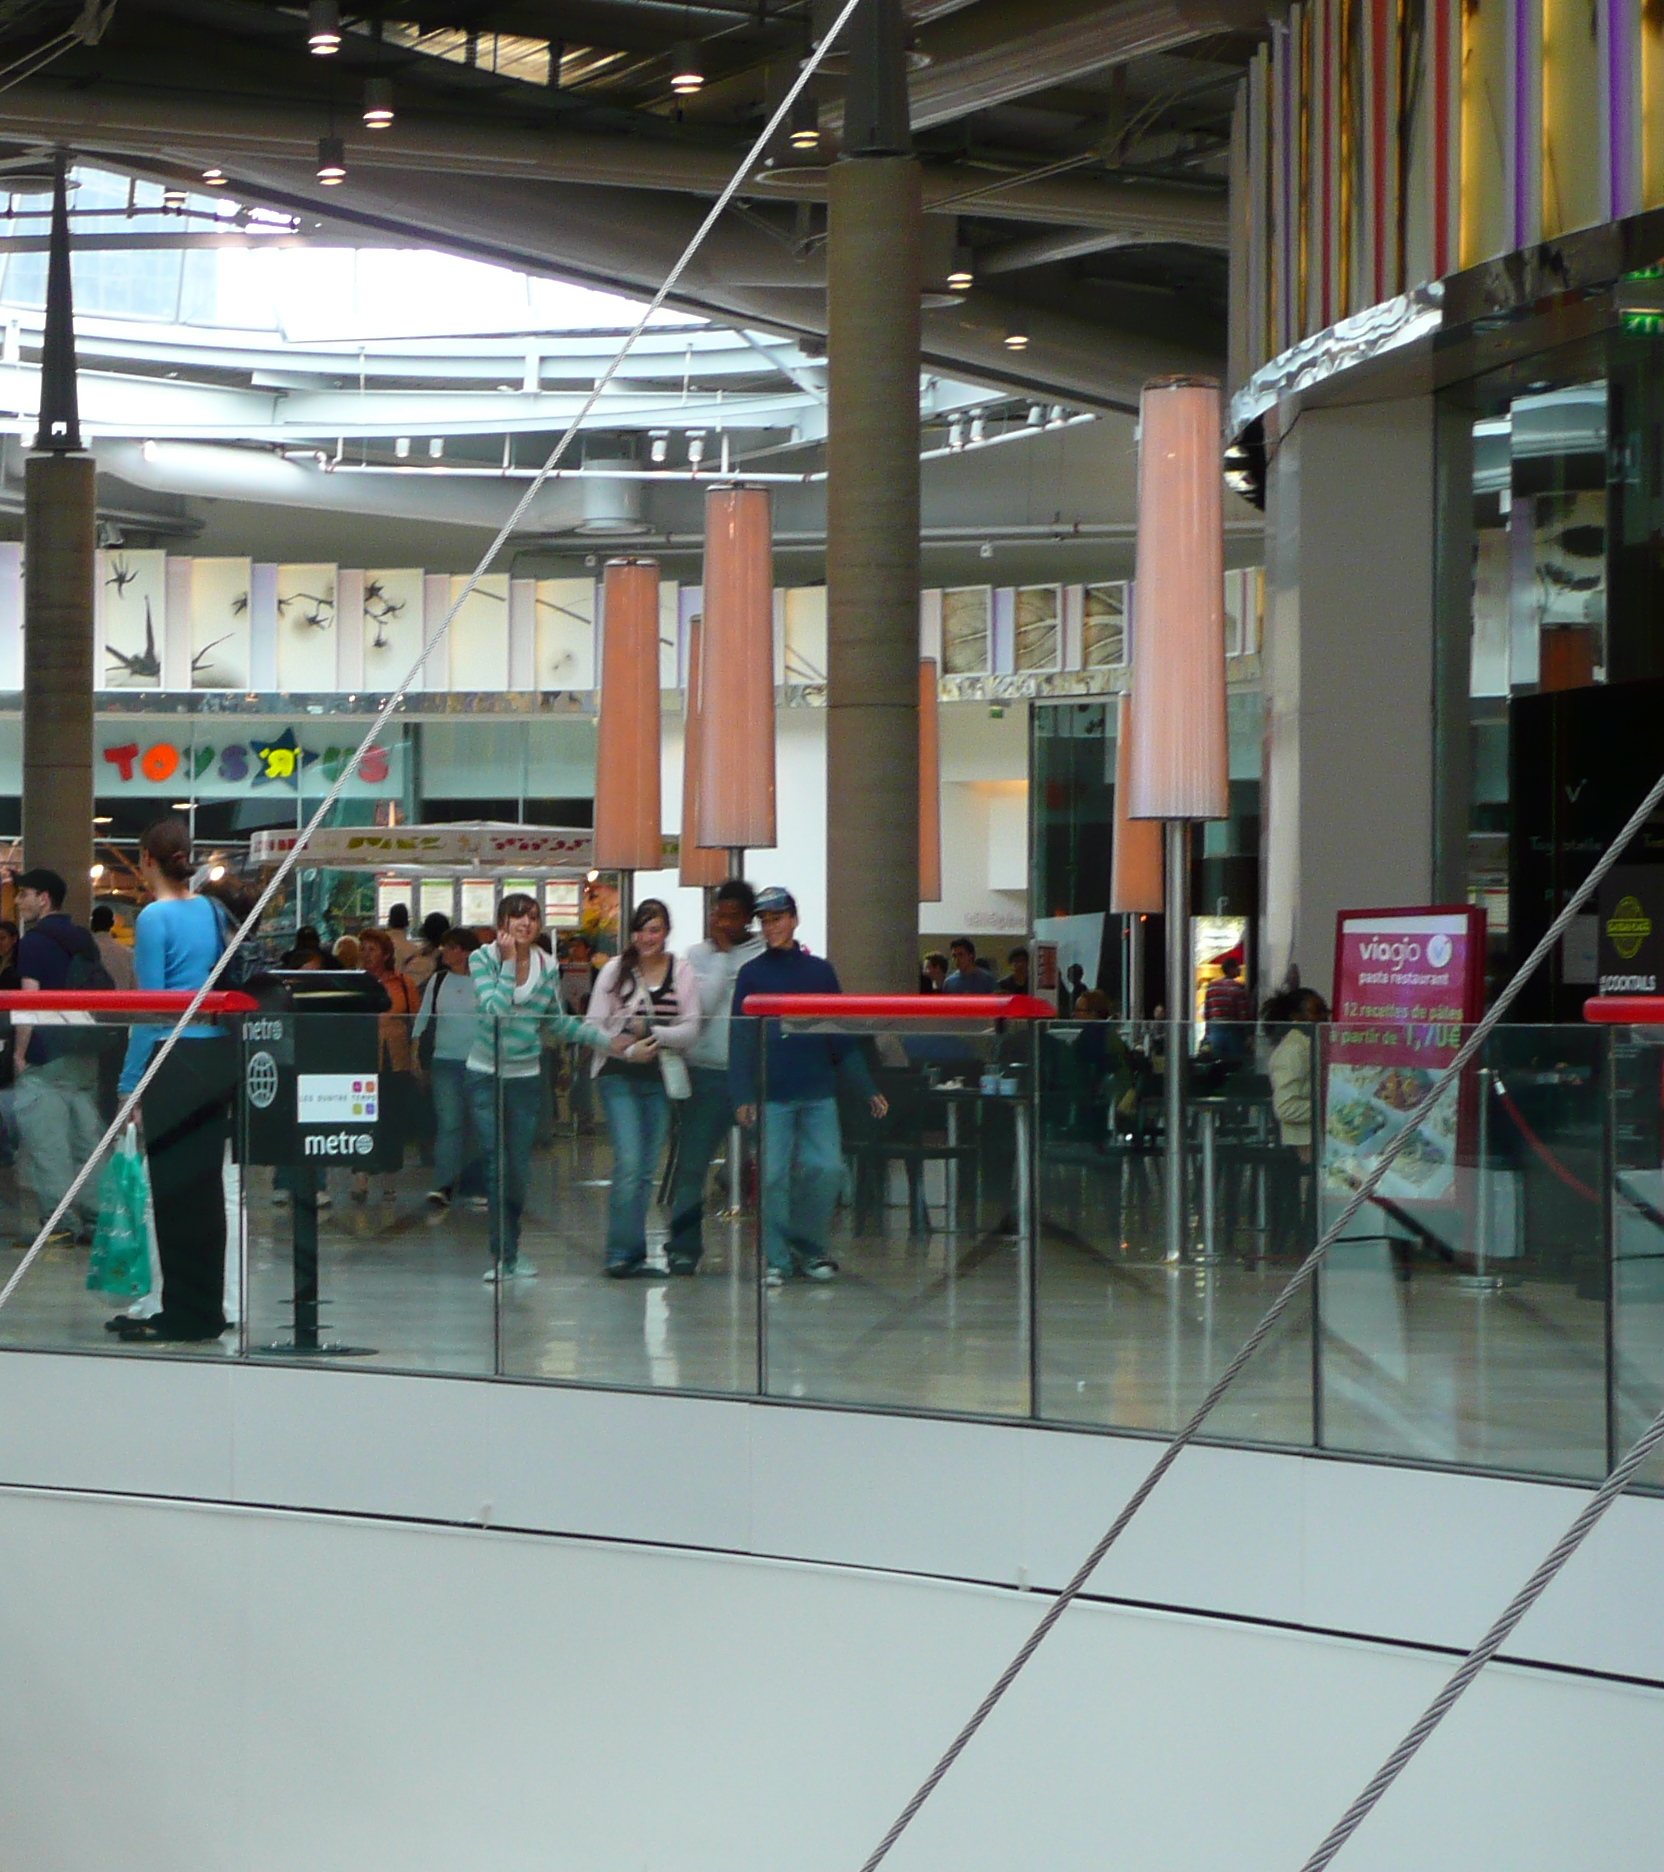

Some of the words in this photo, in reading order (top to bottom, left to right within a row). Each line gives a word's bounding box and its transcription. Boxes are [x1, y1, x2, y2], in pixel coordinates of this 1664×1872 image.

[103, 742, 249, 783] TOYS
[322, 745, 389, 784] US
[1358, 935, 1421, 971] viagio
[1358, 971, 1389, 986] pasta
[1390, 971, 1450, 986] restaurant
[1343, 1001, 1359, 1017] 12
[1411, 1004, 1427, 1019] de
[1340, 1028, 1380, 1047] partir
[304, 1131, 375, 1156] metro
